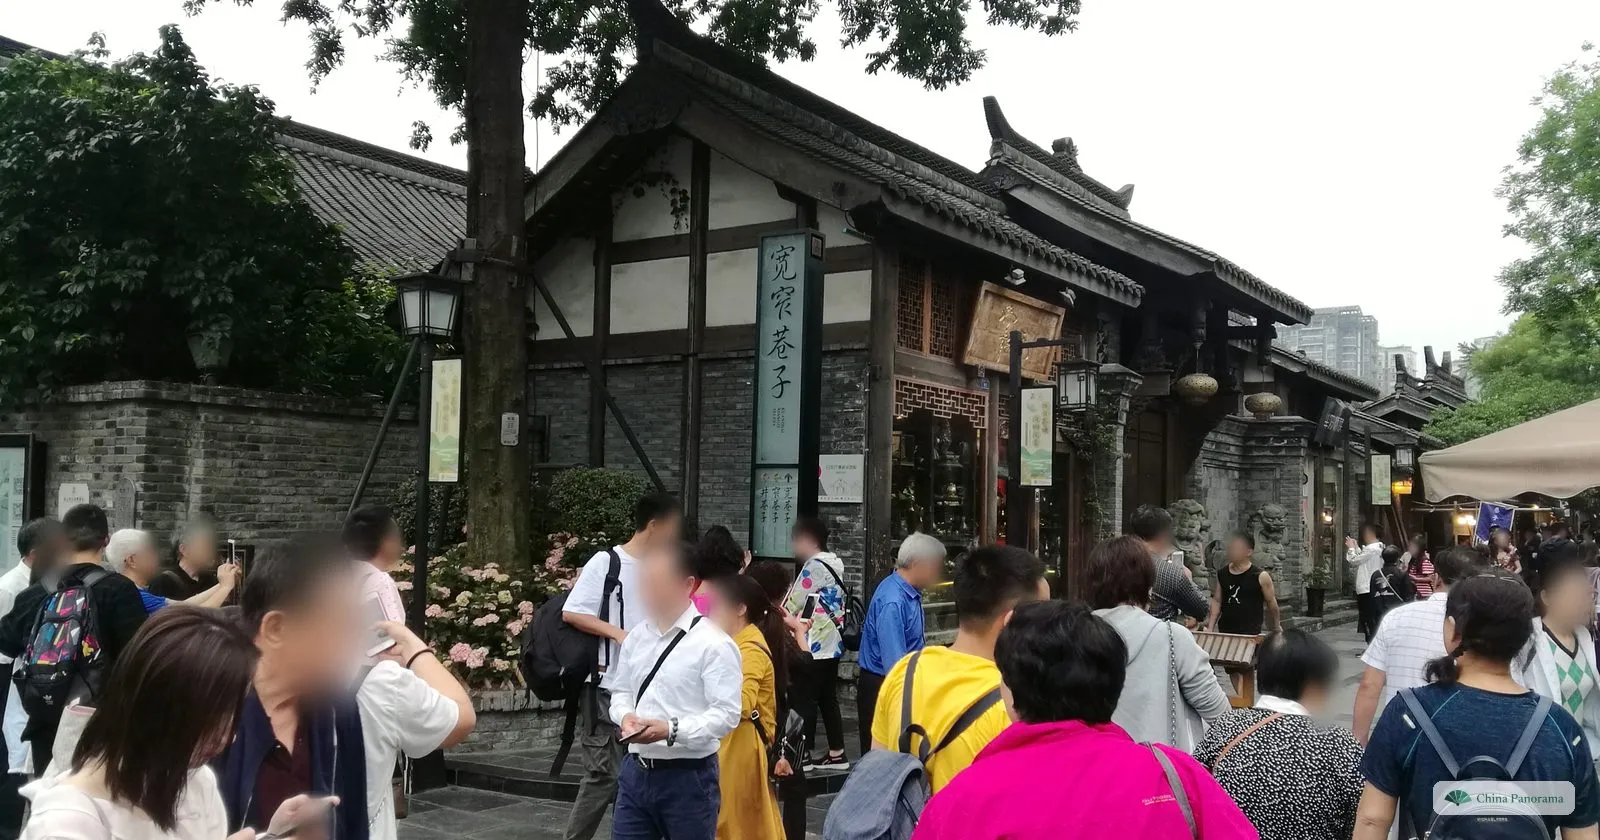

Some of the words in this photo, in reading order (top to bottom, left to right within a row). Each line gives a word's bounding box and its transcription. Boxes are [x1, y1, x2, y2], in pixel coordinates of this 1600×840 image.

[767, 244, 797, 399] 宽窄巷子
[760, 486, 769, 524] 井巷子
[772, 486, 781, 524] 窄巷子
[784, 487, 793, 524] 宽巷子
